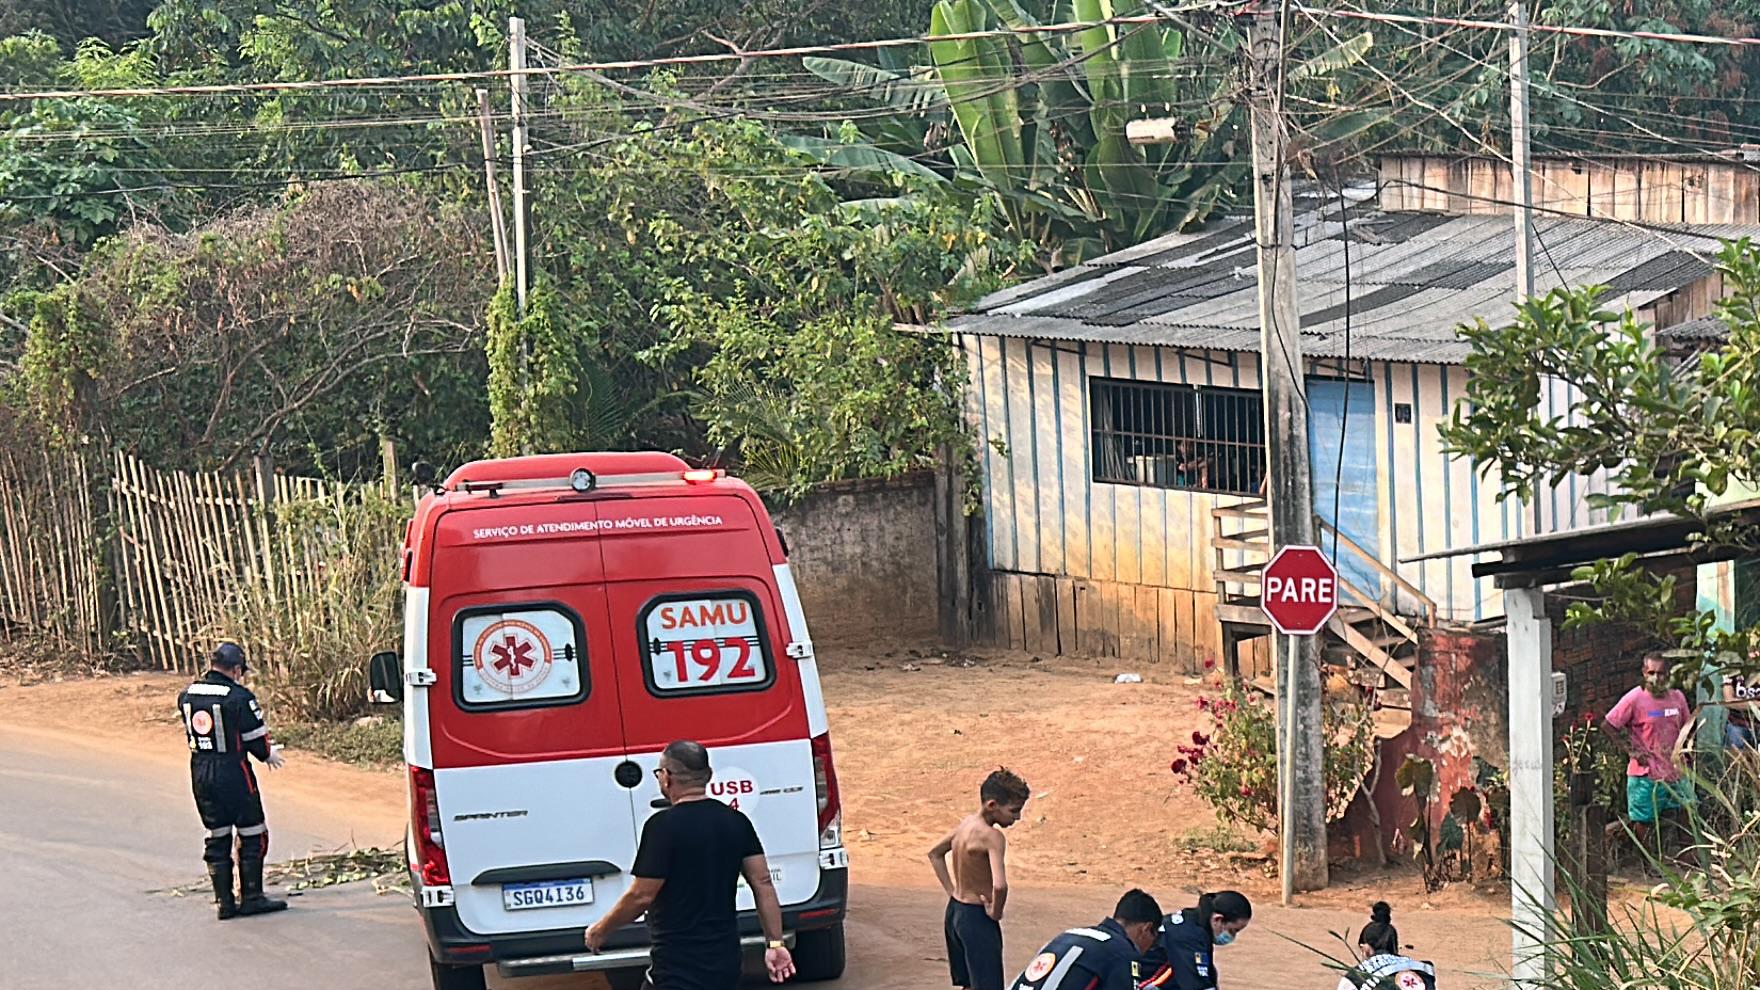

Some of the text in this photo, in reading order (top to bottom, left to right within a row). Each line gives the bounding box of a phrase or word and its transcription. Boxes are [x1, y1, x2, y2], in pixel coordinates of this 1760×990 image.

[473, 514, 723, 539] SERVIÇO DE ATENDIMENTO MÓVEL DE URGÊNCIA
[1266, 576, 1332, 603] PARE
[660, 602, 747, 629] SAMU
[667, 637, 755, 682] 192
[710, 780, 753, 796] USB
[729, 798, 740, 811] 4
